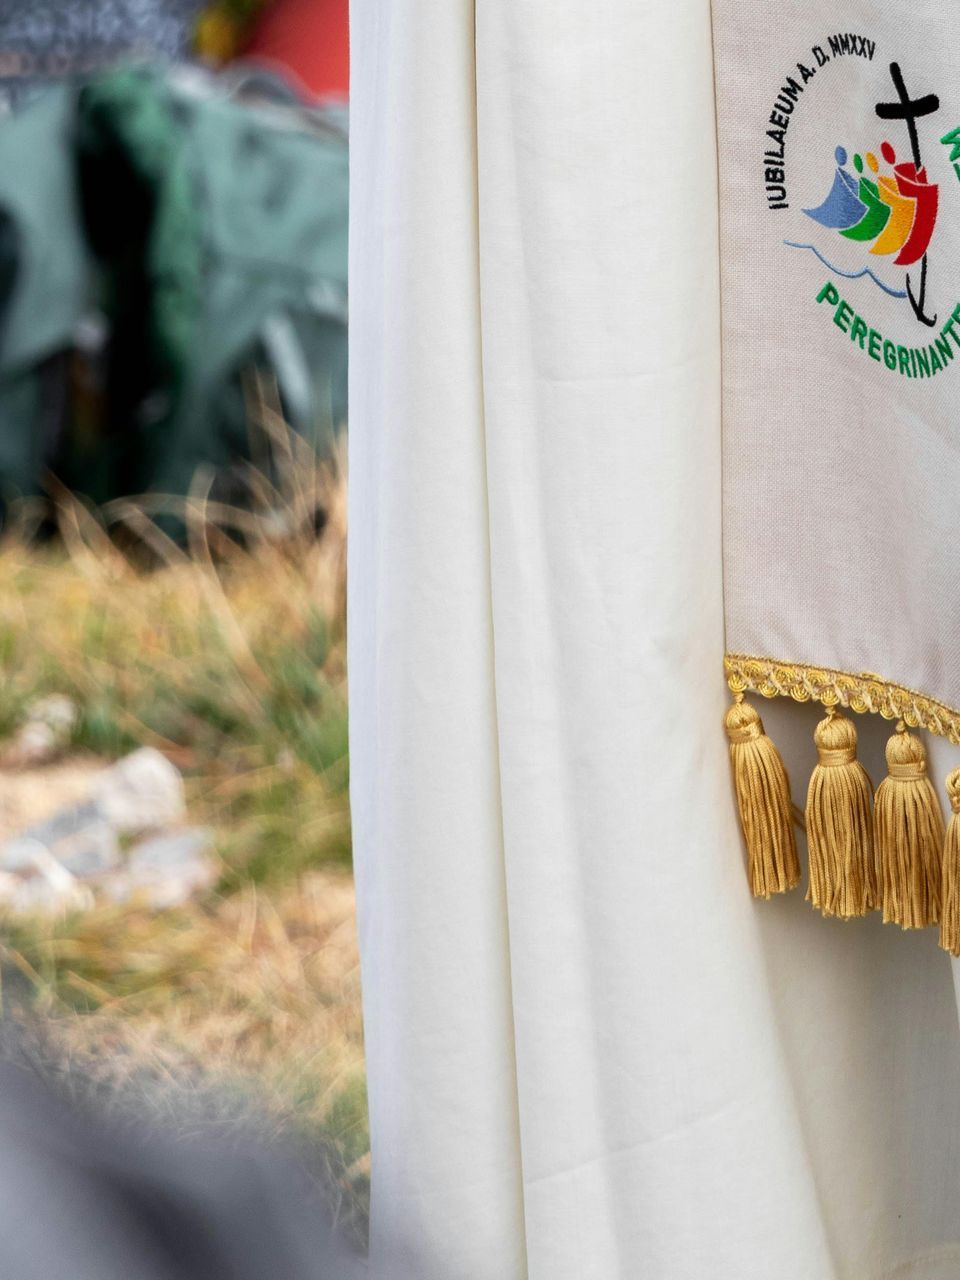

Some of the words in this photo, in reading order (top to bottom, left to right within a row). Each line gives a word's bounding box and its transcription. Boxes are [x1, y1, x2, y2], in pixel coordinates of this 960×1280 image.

[764, 77, 804, 210] IUBILAEUM
[797, 63, 816, 83] A.
[812, 45, 830, 68] D.
[828, 33, 875, 60] MMXXV
